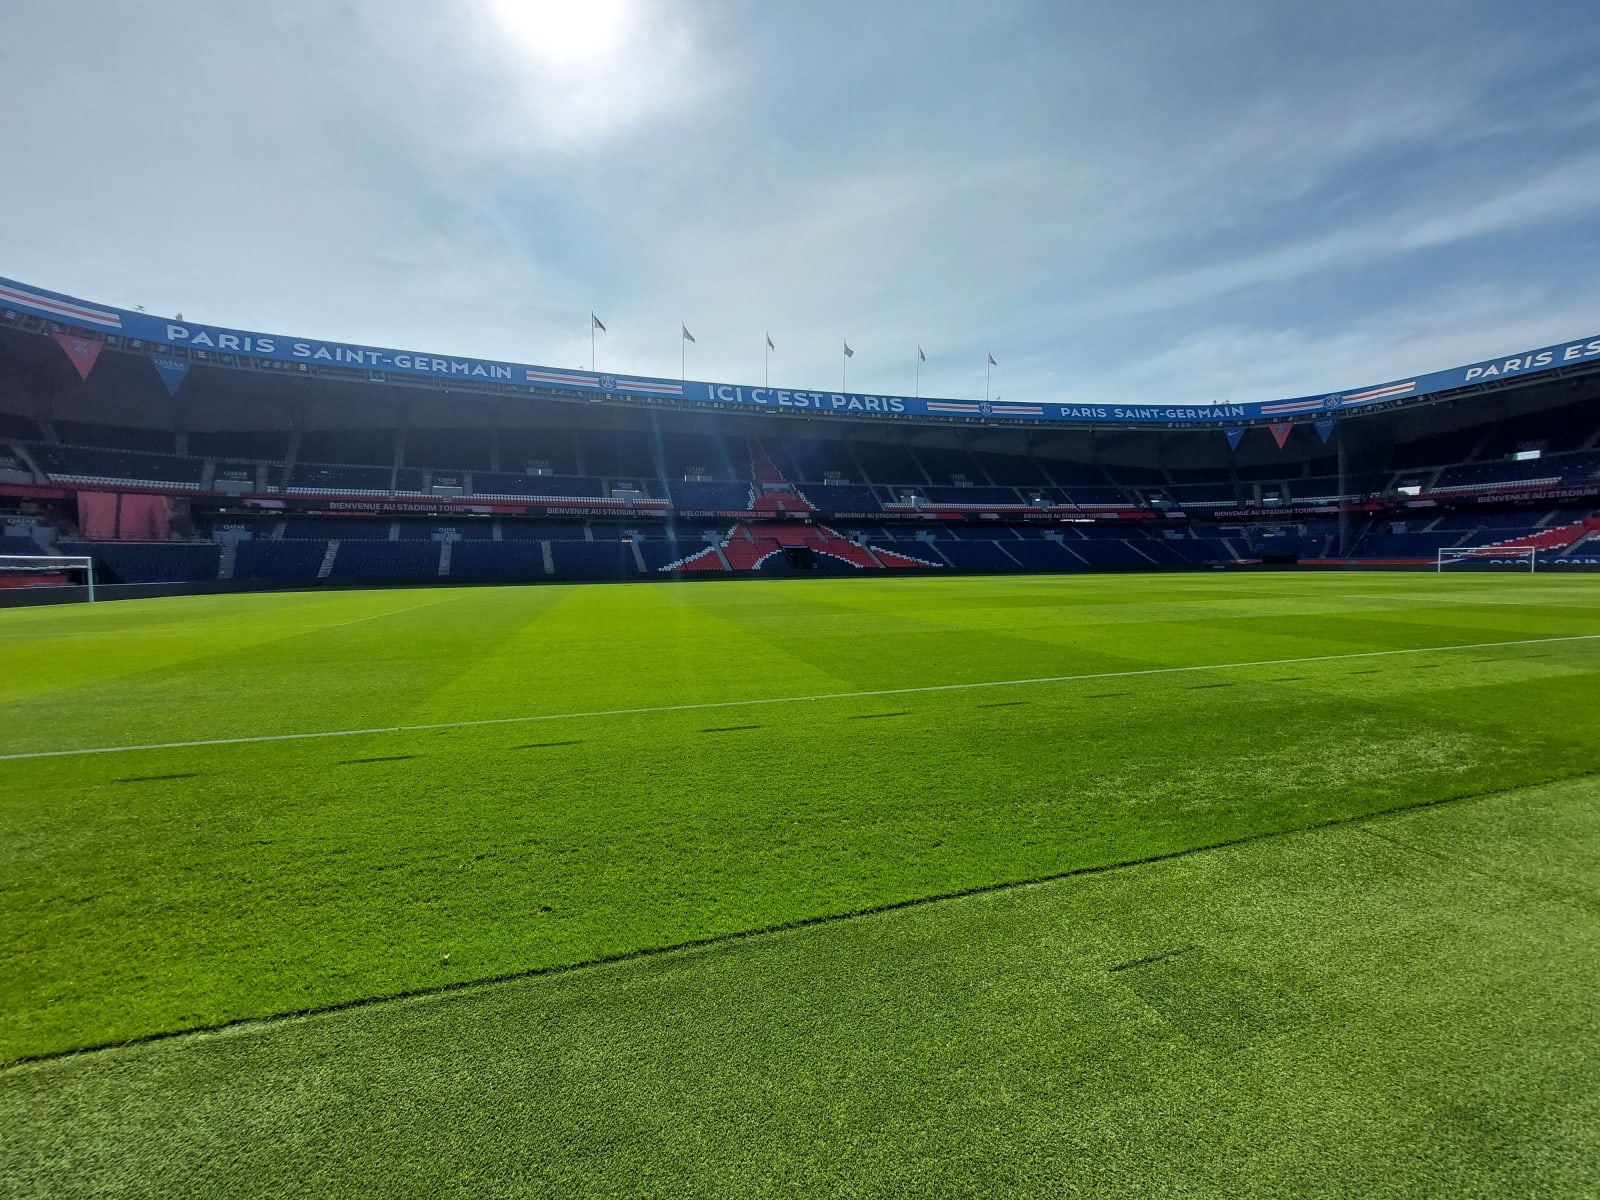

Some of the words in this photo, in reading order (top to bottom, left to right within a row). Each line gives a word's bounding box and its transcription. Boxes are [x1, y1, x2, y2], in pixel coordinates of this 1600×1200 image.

[166, 324, 276, 353] PARIS
[292, 343, 512, 379] SAINT-GERMAIN
[154, 358, 185, 369] QATAR
[1464, 351, 1553, 381] PARIS
[708, 384, 743, 402] ICI
[751, 388, 824, 408] C'EST
[831, 394, 905, 412] PARIS
[1060, 407, 1107, 418] PARIS
[1113, 405, 1245, 419] SAINT-GERMAIN
[1477, 493, 1530, 503] BIENVENUE
[1532, 491, 1547, 499] AU
[1547, 488, 1599, 498] STADIUM
[329, 502, 381, 511] BIENVENUE
[383, 503, 396, 511] AU
[396, 503, 437, 512] STADIUM
[602, 508, 636, 516] STADIUM
[7, 518, 37, 526] QATAR
